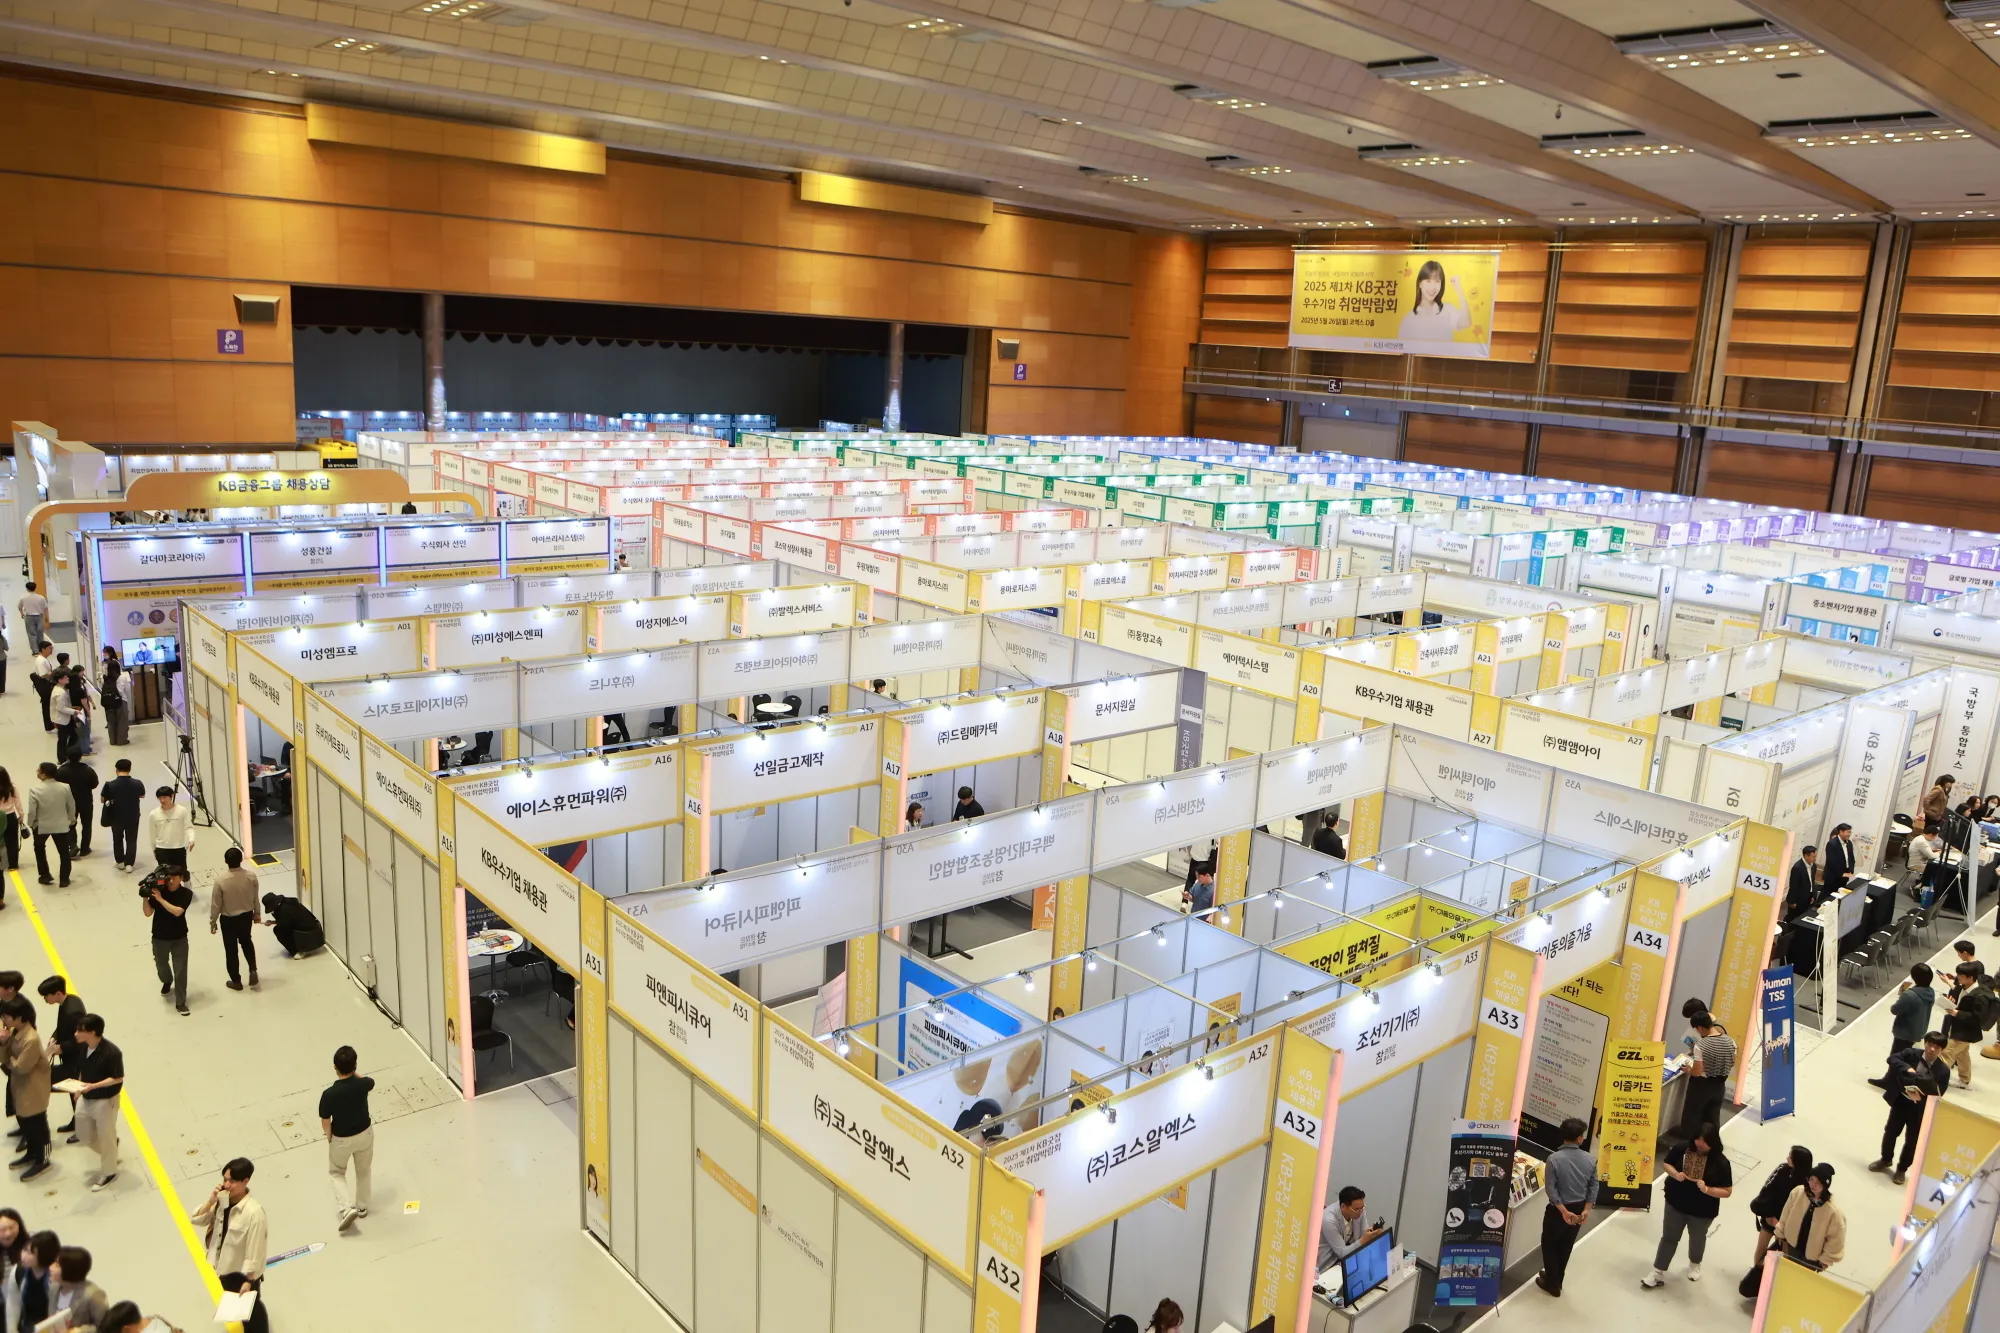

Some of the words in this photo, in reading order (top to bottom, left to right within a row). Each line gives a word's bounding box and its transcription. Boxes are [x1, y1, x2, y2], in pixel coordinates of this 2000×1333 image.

[1304, 281, 1326, 292] 2025
[1329, 282, 1352, 294] 제1차
[1356, 281, 1398, 296] KB굿잡
[1303, 298, 1336, 310] 우수기업
[1339, 297, 1398, 313] 취업박람회
[1301, 317, 1318, 325] 2025년
[1319, 318, 1328, 326] 5월
[218, 479, 282, 493] KB금융그룹
[286, 477, 331, 491] 채용상담
[301, 546, 333, 556] 성풍건설
[421, 540, 450, 550] 주식회사
[453, 539, 467, 549] 선인
[1000, 583, 1037, 595] 용마로지스(주)
[1067, 589, 1078, 598] A05
[969, 598, 980, 608] A05
[1812, 598, 1854, 614] 중소벤처기업
[1855, 605, 1878, 618] 채용관
[566, 609, 579, 617] A02
[397, 623, 411, 631] A01
[635, 615, 688, 630] 미성지에스이
[1178, 626, 1188, 634] A11
[471, 628, 544, 646] (주)미성에스엔피
[1083, 630, 1096, 640] A11
[1127, 628, 1163, 647] (주)동양고속
[1546, 639, 1561, 649] A22
[1606, 630, 1621, 640] A23
[301, 645, 359, 662] 미성엠프로
[1283, 652, 1295, 660] A20
[1477, 653, 1492, 663] A21
[1222, 652, 1269, 674] 에이텍시스템
[1302, 684, 1318, 696] A20
[1026, 696, 1039, 705] A18
[1095, 698, 1136, 717] 문서지원실
[1354, 683, 1403, 709] KB우수기업
[1404, 697, 1434, 718] 채용관
[1962, 686, 1980, 721] 국방부
[859, 722, 875, 732] A17
[937, 721, 999, 746] (주)드림메카텍
[1047, 730, 1064, 745] A18
[1472, 731, 1492, 745] A27
[1542, 733, 1601, 760] (주)앰앰아이
[1627, 736, 1643, 747] A27
[1866, 730, 1880, 749] KB
[1952, 724, 1972, 770] 통합부스
[654, 754, 673, 765] A16
[753, 751, 826, 778] 선일금고제작
[886, 761, 902, 776] A17
[1860, 751, 1875, 774] 소호
[376, 770, 423, 819] 에이스휴먼파워(주)
[506, 784, 628, 819] 에이스휴먼파워(주)
[1726, 786, 1743, 809] KB
[1851, 776, 1871, 810] 컨설팅
[688, 800, 703, 815] A16
[480, 846, 522, 889] KB우수기업
[521, 877, 548, 914] 채용관
[1616, 882, 1629, 896] A34
[1743, 872, 1771, 891] A35
[1347, 933, 1383, 966] 펼쳐질
[1536, 921, 1593, 961] 이동의즐거움
[1632, 930, 1663, 951] A34
[585, 952, 602, 975] A31
[1463, 950, 1479, 966] A33
[1584, 979, 1604, 995] 되는
[1763, 975, 1792, 992] Human
[645, 972, 712, 1039] 피앤피시큐어
[1768, 990, 1786, 1004] TSS
[732, 1002, 750, 1022] A31
[1487, 1006, 1519, 1030] A33
[924, 1018, 973, 1054] 피앤피시큐어
[1355, 1004, 1421, 1052] 조선기기(주)
[1248, 1043, 1269, 1064] A32
[1612, 1080, 1653, 1092] 이즐카드
[1282, 1110, 1317, 1140] A32
[1475, 1121, 1500, 1131] chosun
[814, 1093, 912, 1182] (주)코스알엑스
[941, 1143, 965, 1170] A32
[1003, 1151, 1019, 1165] 2025
[1036, 1132, 1062, 1152] KB굿잡
[1026, 1142, 1062, 1166] 취업박람회
[1086, 1112, 1198, 1184] (주)코스알엑스
[985, 1255, 1021, 1293] A32
